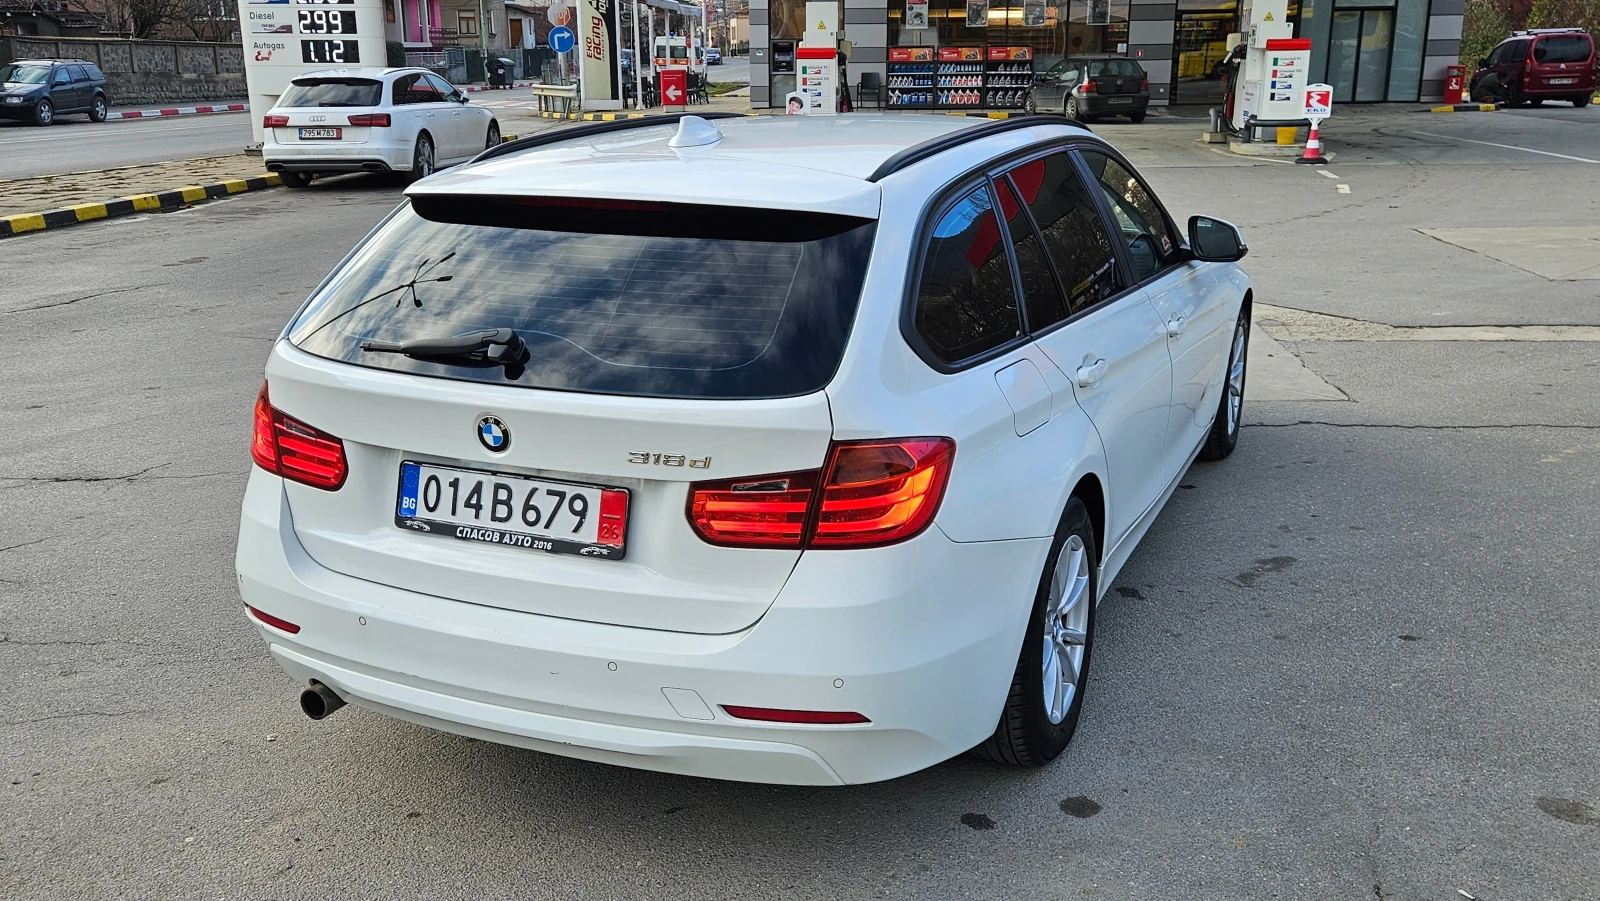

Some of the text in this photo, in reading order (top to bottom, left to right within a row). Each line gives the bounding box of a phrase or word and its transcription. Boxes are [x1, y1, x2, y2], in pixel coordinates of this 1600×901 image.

[249, 12, 275, 20] Diesel
[299, 11, 342, 34] 2.99
[254, 41, 285, 51] Autogas
[592, 16, 603, 61] racing
[309, 40, 344, 63] 1.12
[478, 416, 506, 431] BMW
[628, 450, 712, 469] 318d
[402, 496, 416, 510] BG
[423, 474, 589, 534] 014B679
[456, 526, 553, 550] СПАСОВ АУТО 2016
[601, 523, 619, 539] 26
